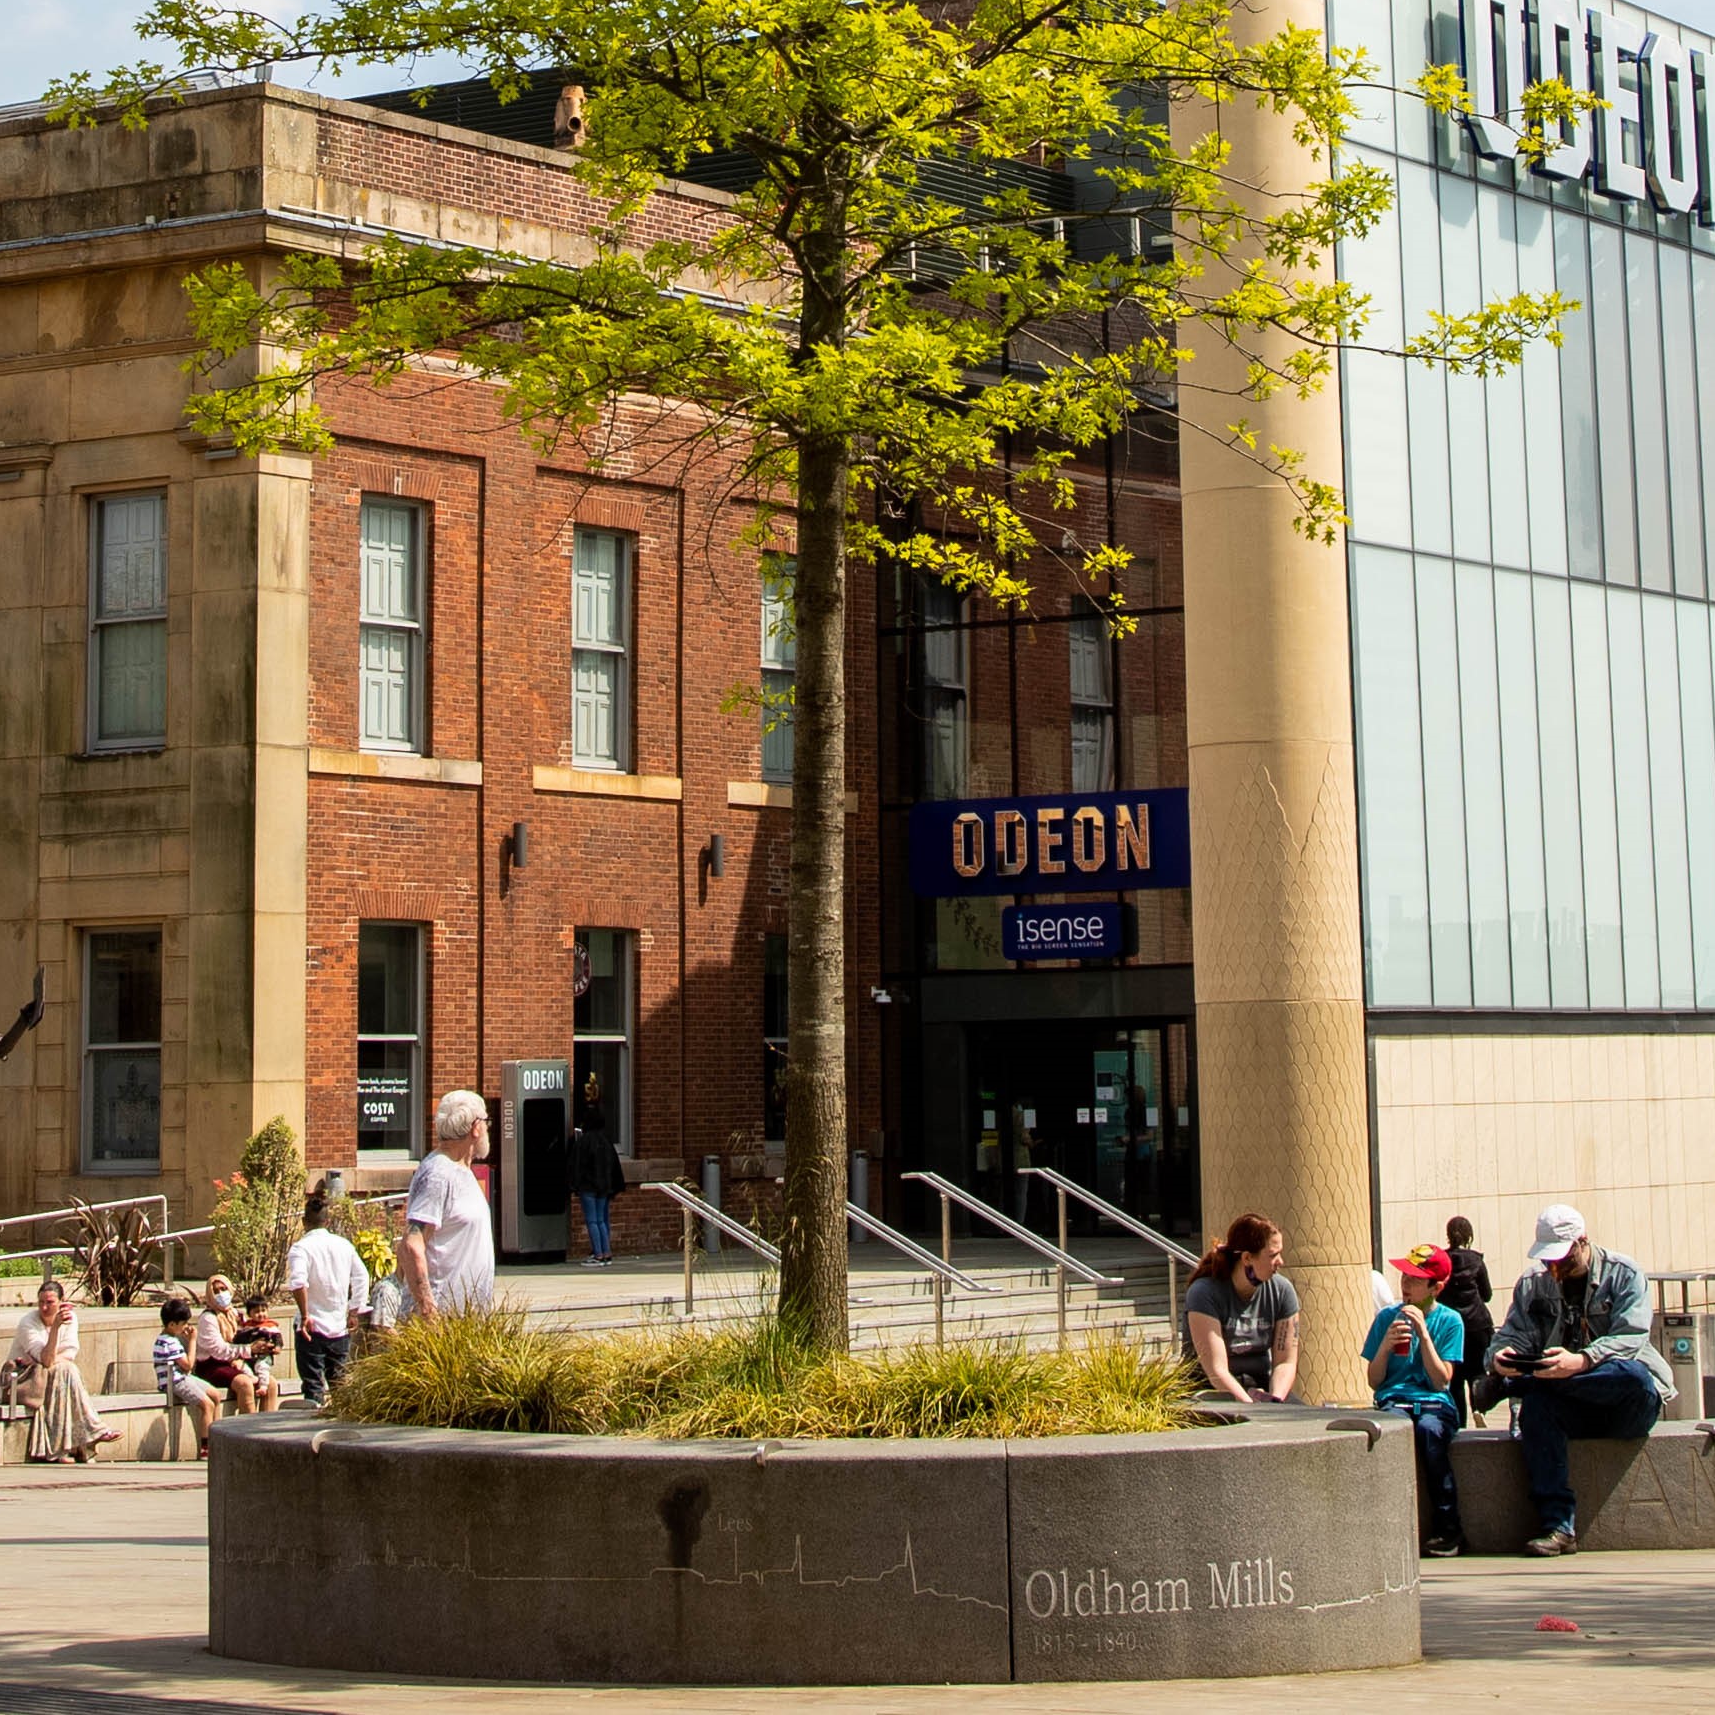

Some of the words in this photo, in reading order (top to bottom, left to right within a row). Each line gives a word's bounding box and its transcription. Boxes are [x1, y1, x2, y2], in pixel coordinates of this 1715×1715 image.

[953, 803, 1151, 877] ODEON
[1016, 913, 1104, 942] isense
[1044, 942, 1068, 950] SCREEN
[1070, 940, 1104, 949] SENSATION
[523, 1070, 564, 1090] ODEON
[363, 1102, 395, 1116] COSTA
[504, 1100, 514, 1139] ODEON
[718, 1513, 753, 1533] Lees
[1025, 1561, 1192, 1619] Oldham
[1207, 1557, 1295, 1609] Mills
[1034, 1634, 1076, 1655] 1815
